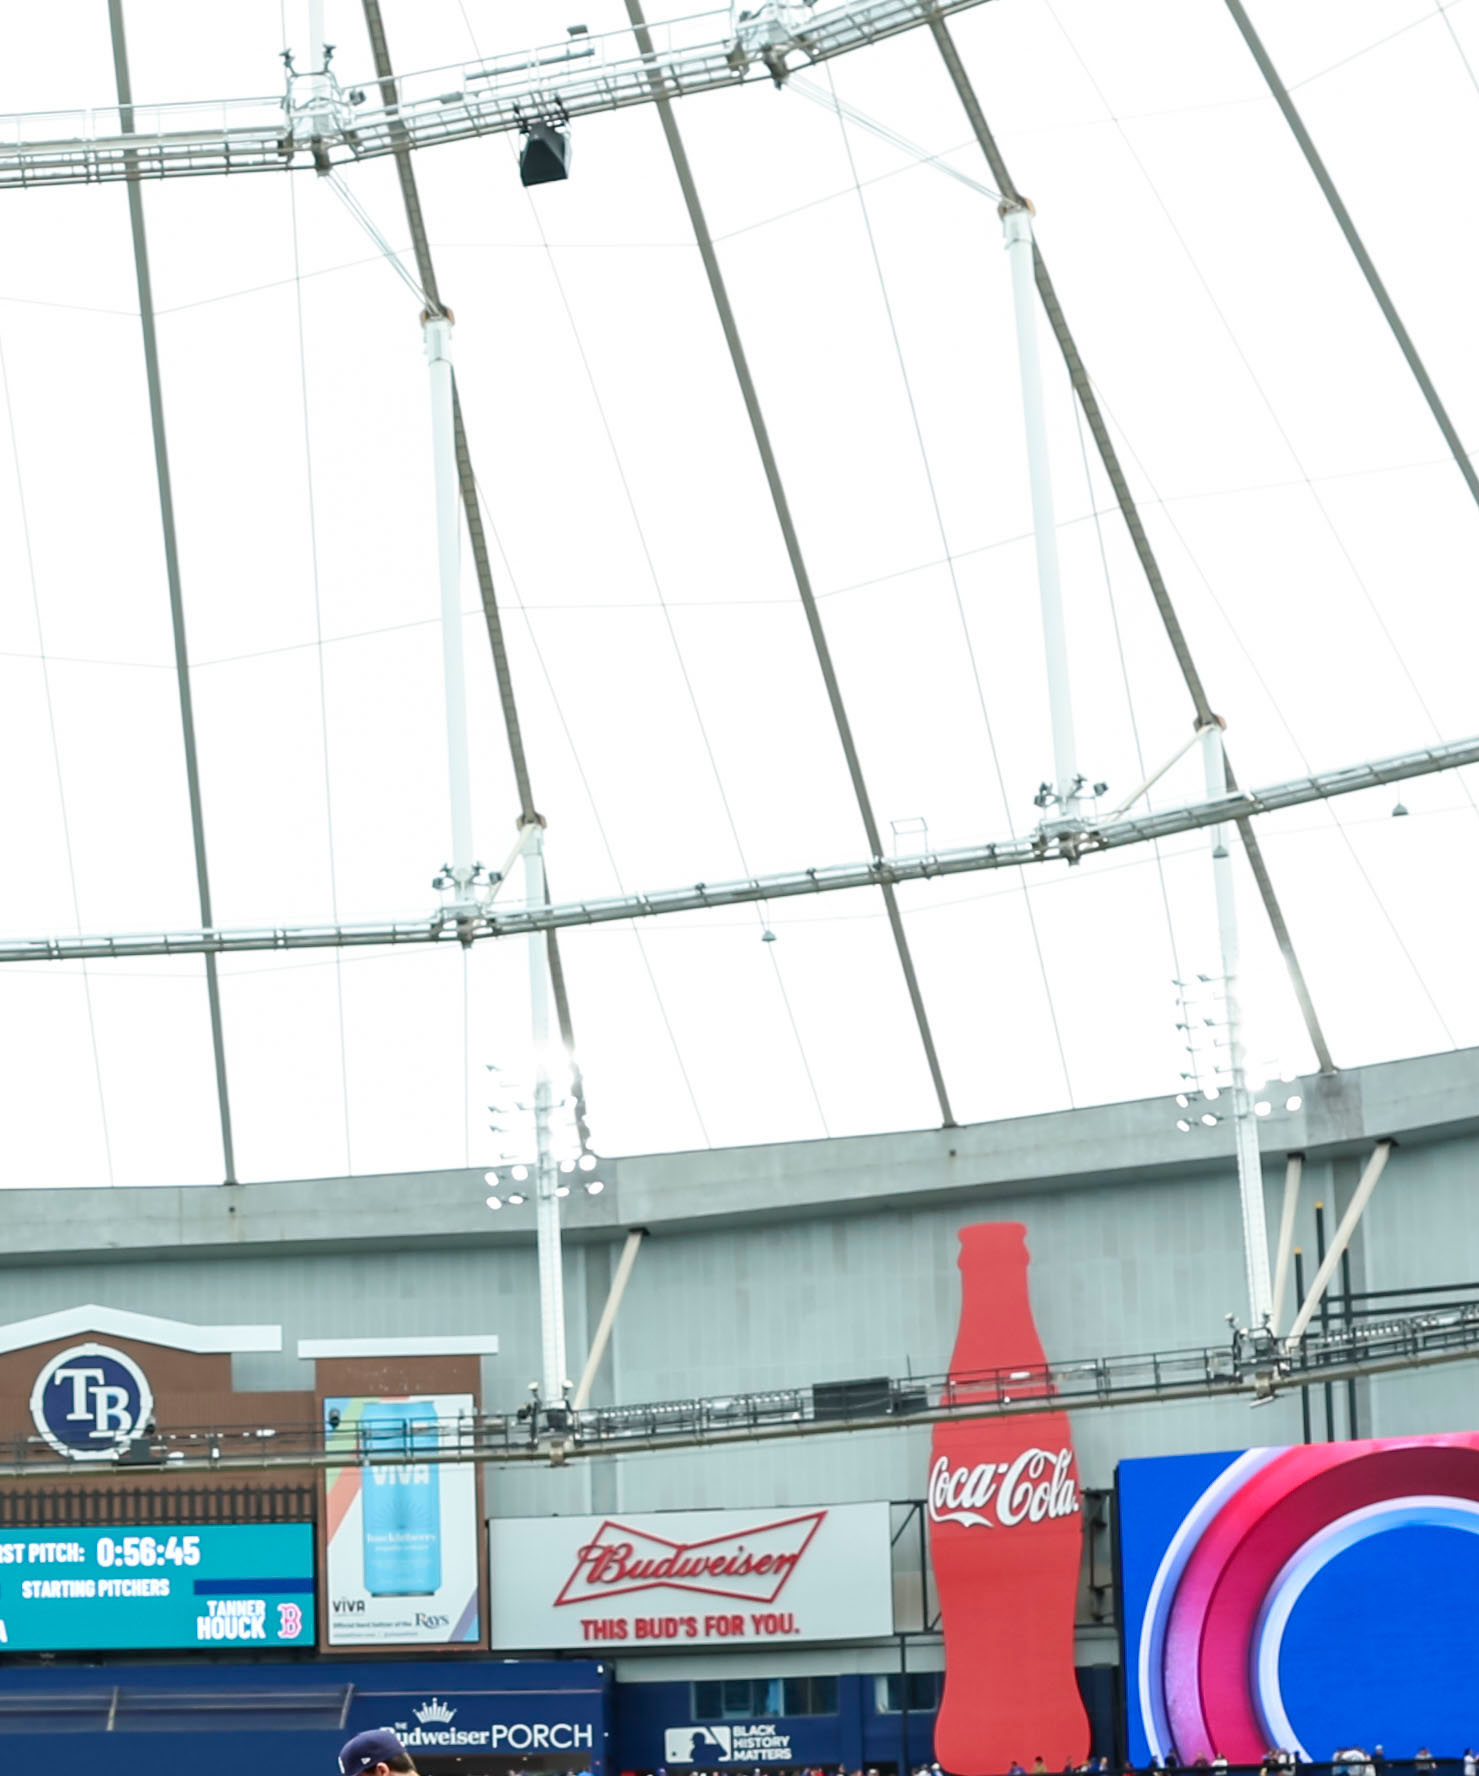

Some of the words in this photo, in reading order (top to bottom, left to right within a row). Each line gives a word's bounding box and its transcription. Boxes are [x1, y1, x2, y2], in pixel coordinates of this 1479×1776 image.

[54, 1367, 133, 1439] TB
[28, 1542, 86, 1564] PITCH:
[96, 1535, 201, 1567] 0:56:45
[576, 1542, 801, 1585] Budweiser
[21, 1579, 96, 1599] STARTING
[97, 1577, 171, 1598] PITCHERS
[206, 1600, 266, 1617] TANNER
[332, 1600, 366, 1613] VIVA
[196, 1615, 267, 1640] HOUCK
[580, 1617, 628, 1641] THIS
[634, 1616, 699, 1640] BUD'S
[703, 1615, 745, 1638] FOR
[750, 1612, 801, 1636] YOU.
[492, 1723, 593, 1750] PORCH
[733, 1725, 776, 1737] BLACK
[733, 1737, 790, 1749] HISTORY
[733, 1748, 792, 1761] MATTERS
